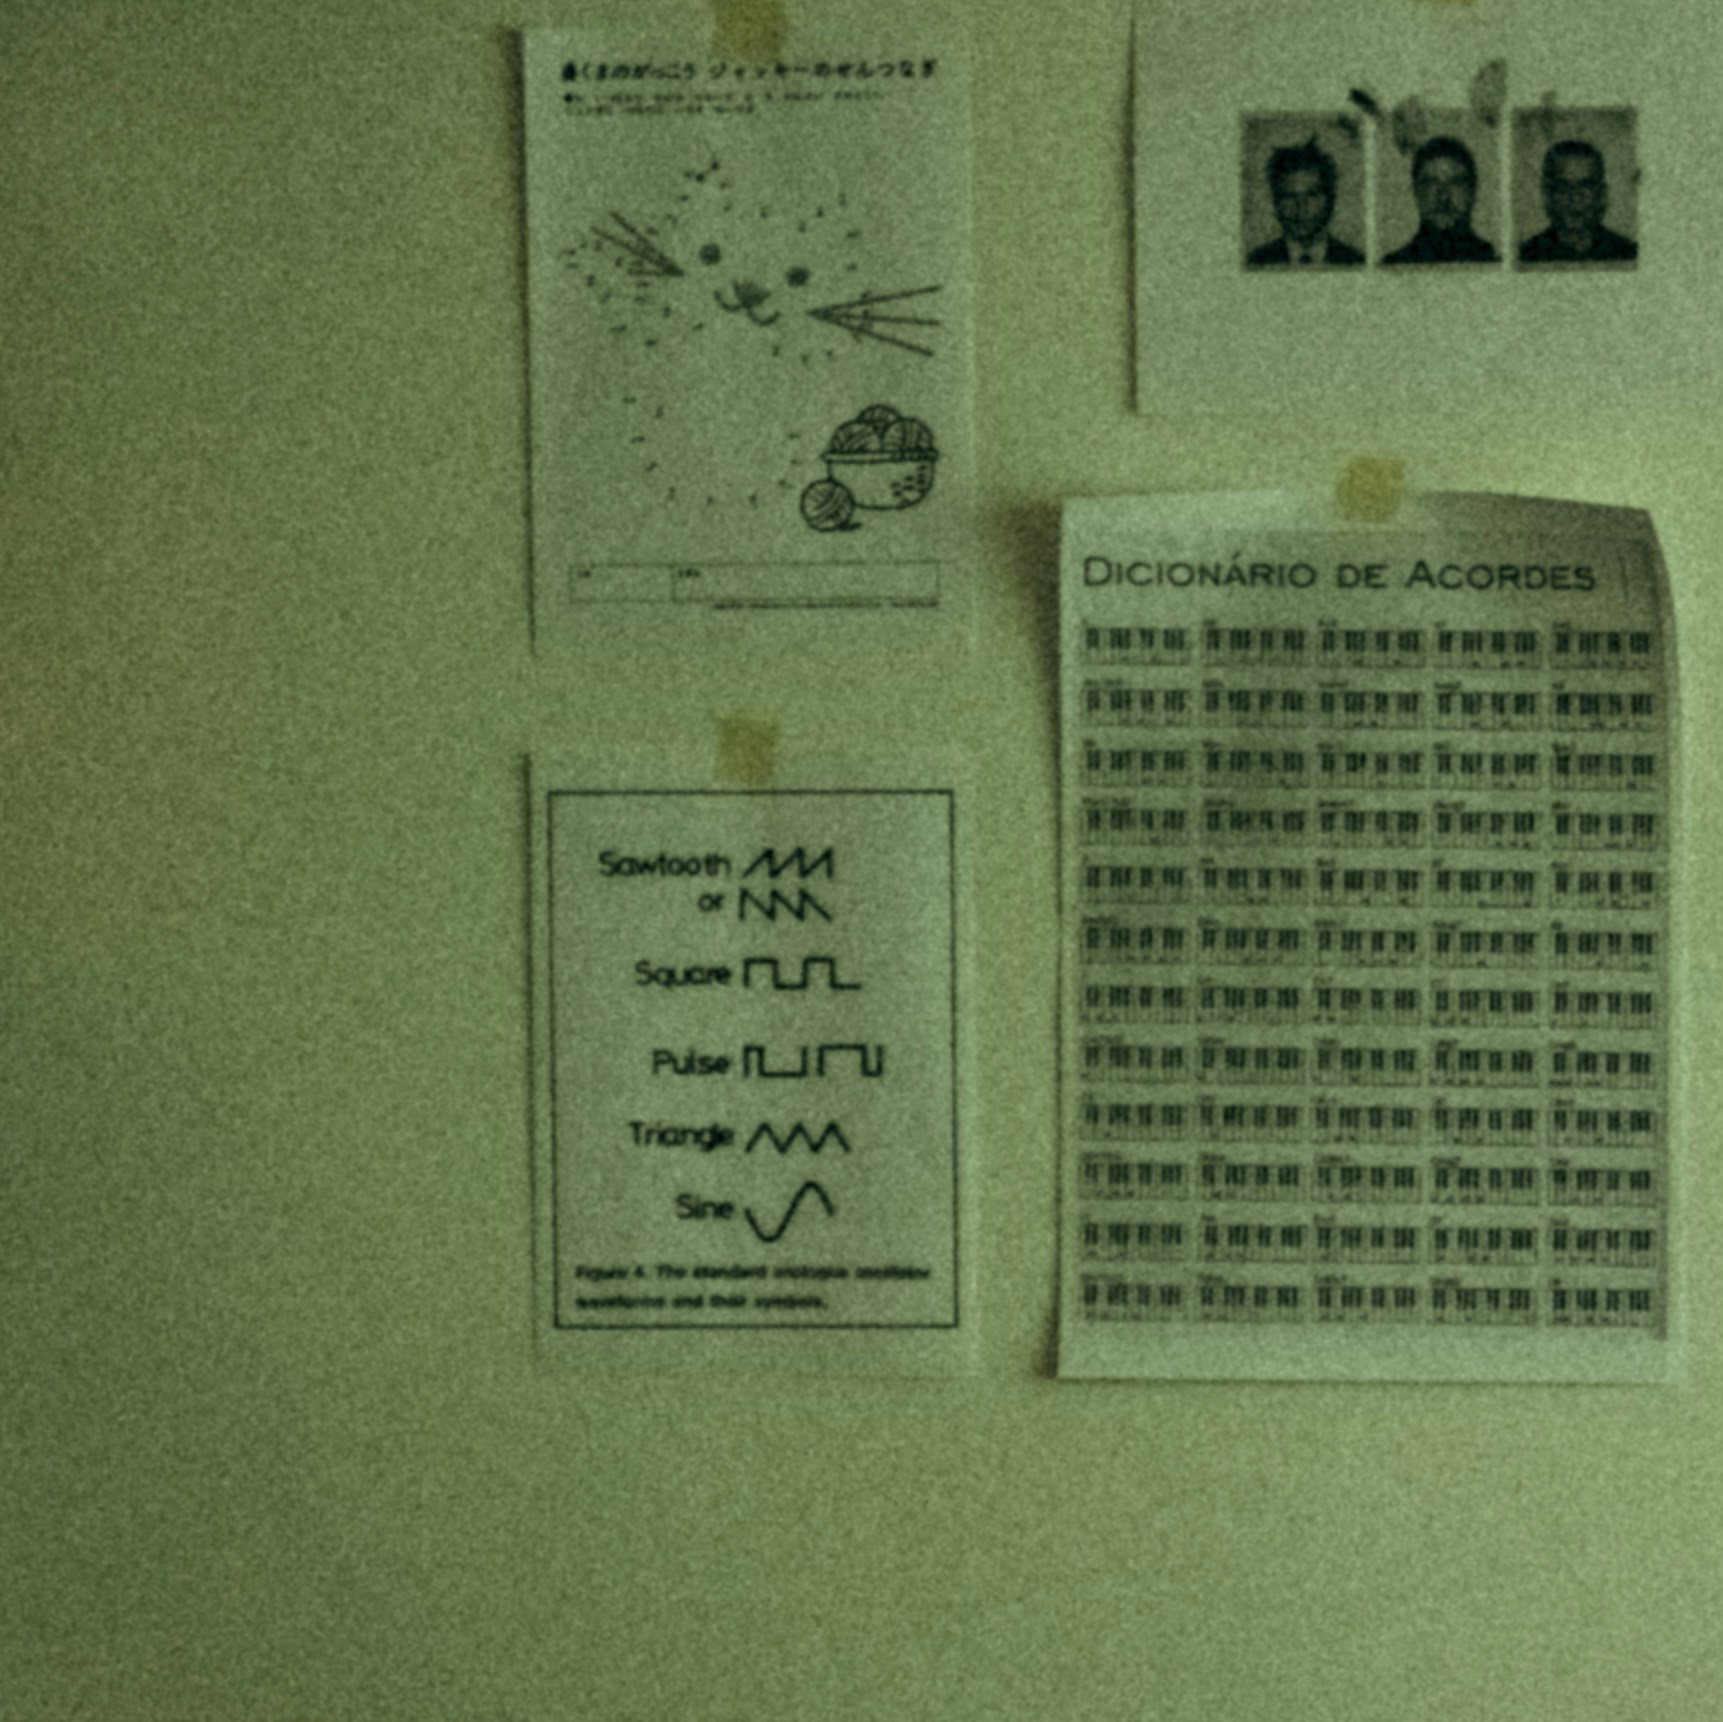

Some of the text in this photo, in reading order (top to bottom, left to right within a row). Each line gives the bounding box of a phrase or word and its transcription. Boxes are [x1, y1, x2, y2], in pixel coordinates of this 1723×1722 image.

[599, 850, 732, 878] Sawtooth
[698, 893, 724, 912] or
[634, 959, 733, 991] Square
[651, 1049, 731, 1077] Pulse
[628, 1121, 735, 1154] Triangle
[674, 1193, 735, 1220] Sine
